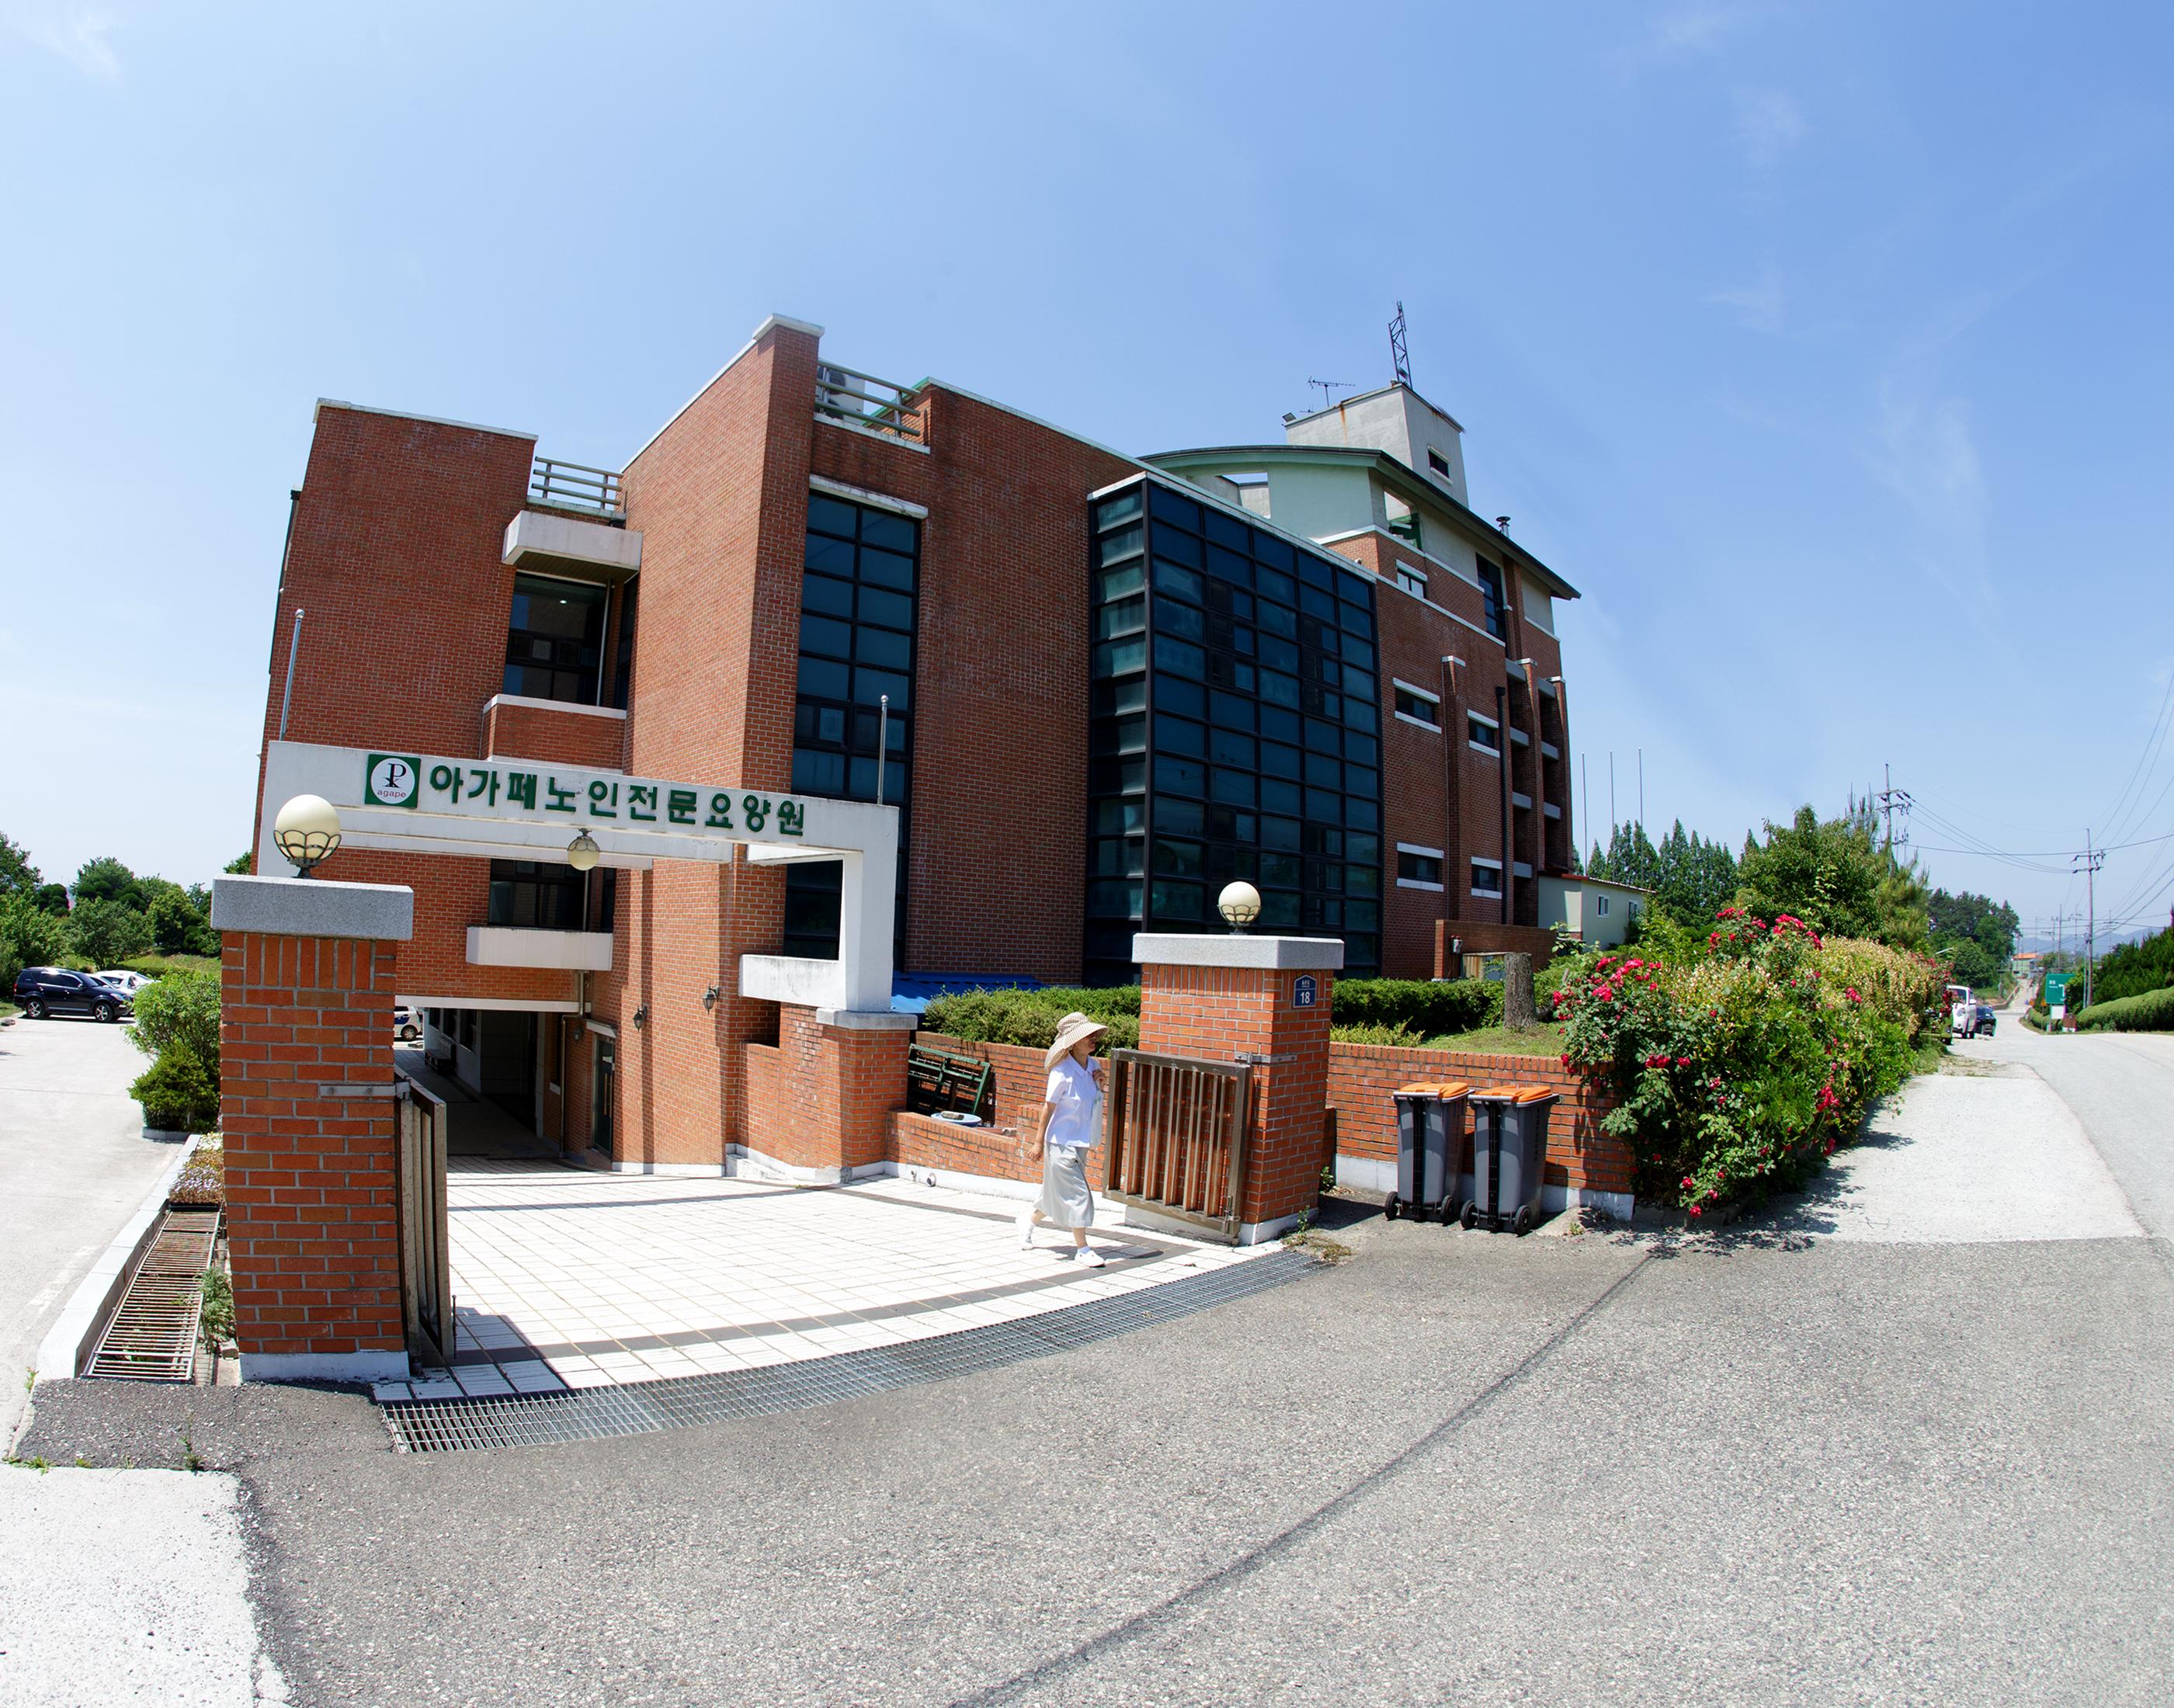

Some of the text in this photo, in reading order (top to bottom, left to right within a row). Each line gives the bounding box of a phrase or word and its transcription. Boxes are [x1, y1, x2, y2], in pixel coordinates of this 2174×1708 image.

[377, 790, 407, 798] agape
[429, 765, 804, 837] 아가페노인전문요양원
[1301, 991, 1311, 1004] 18
